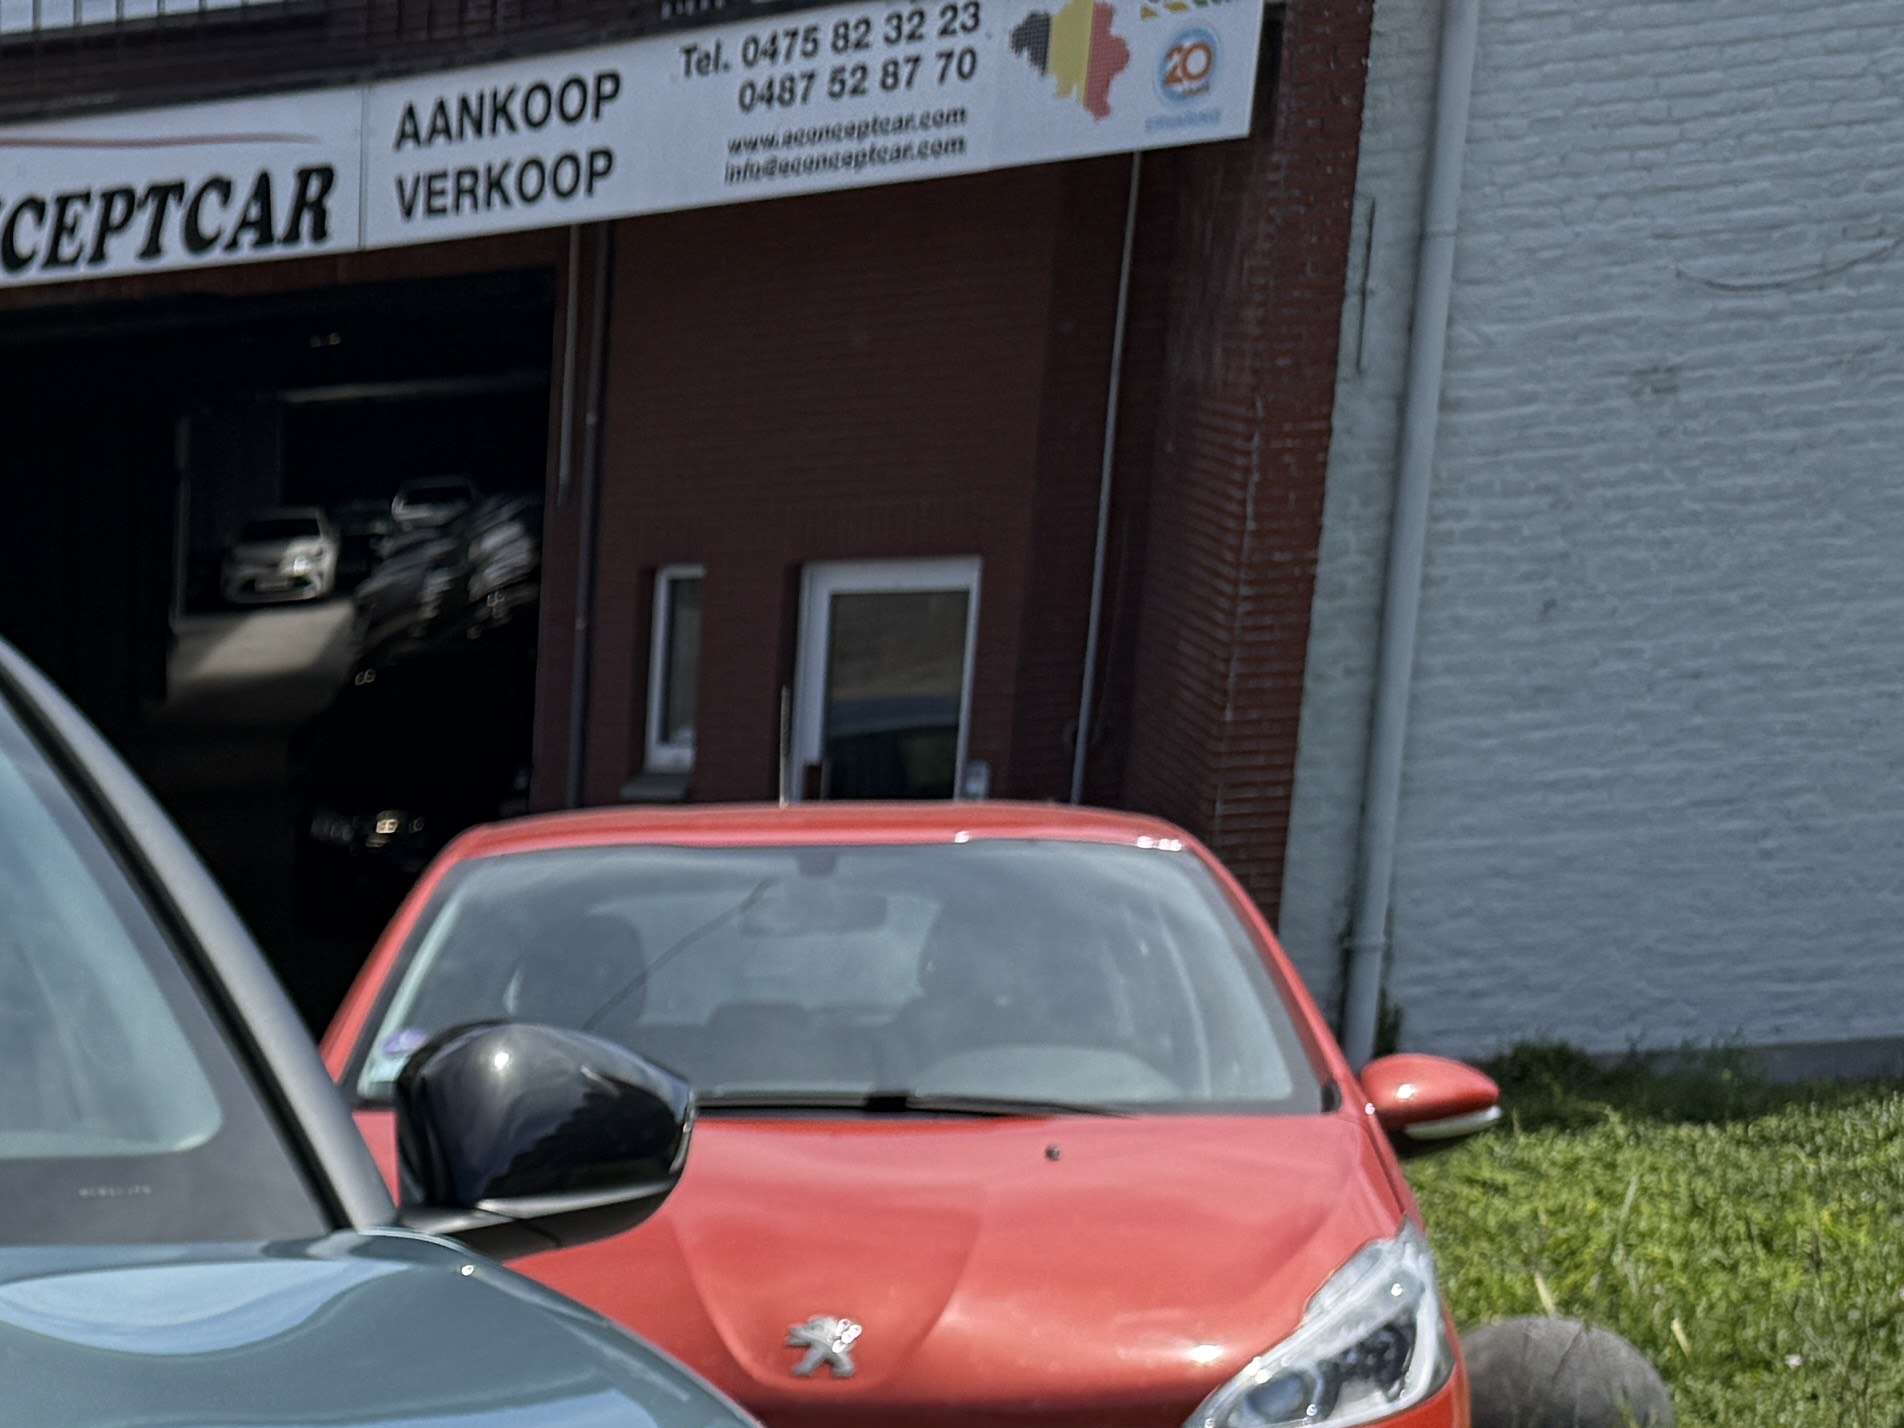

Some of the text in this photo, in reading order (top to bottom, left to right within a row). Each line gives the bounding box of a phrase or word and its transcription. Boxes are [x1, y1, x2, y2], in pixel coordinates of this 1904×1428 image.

[680, 2, 981, 78] Tel. 0475 82 32 23
[394, 71, 620, 152] AANKOOP
[738, 47, 978, 113] 0487 52 87 70
[728, 106, 967, 155] www.econceptcar.com
[395, 149, 613, 222] VERKOOP
